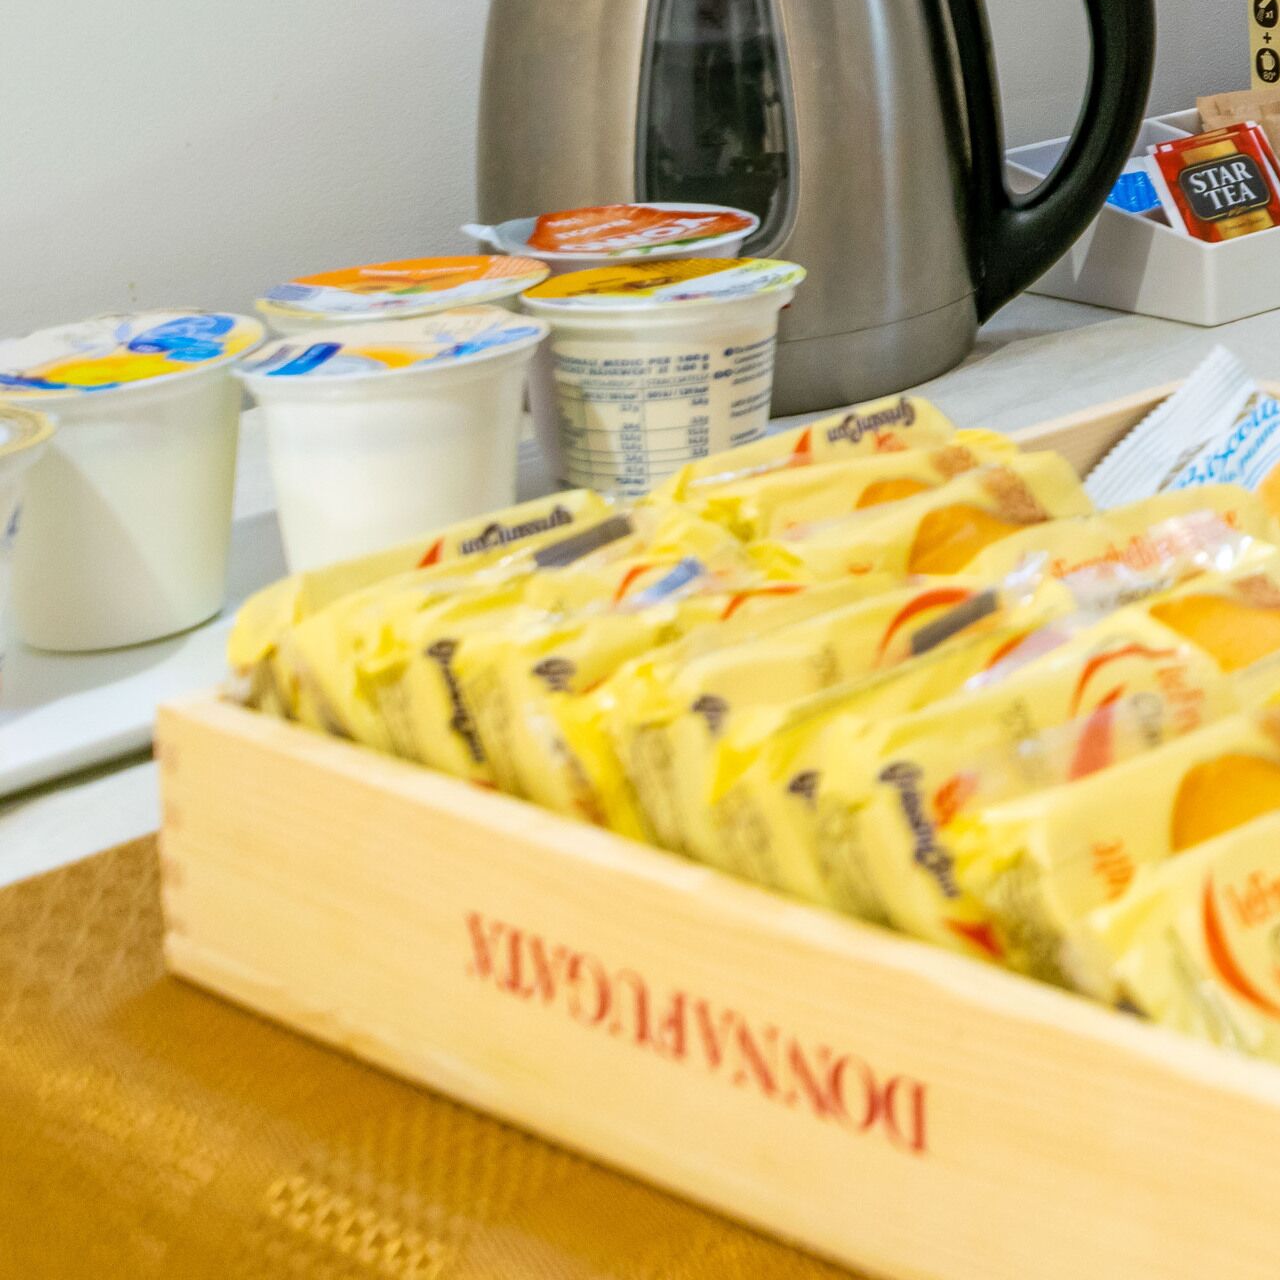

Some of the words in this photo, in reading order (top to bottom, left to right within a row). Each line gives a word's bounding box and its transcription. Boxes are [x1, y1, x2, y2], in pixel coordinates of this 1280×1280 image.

[1188, 161, 1253, 194] STAR
[1203, 181, 1257, 210] TEA
[464, 911, 929, 1157] DONNAFUGATA
